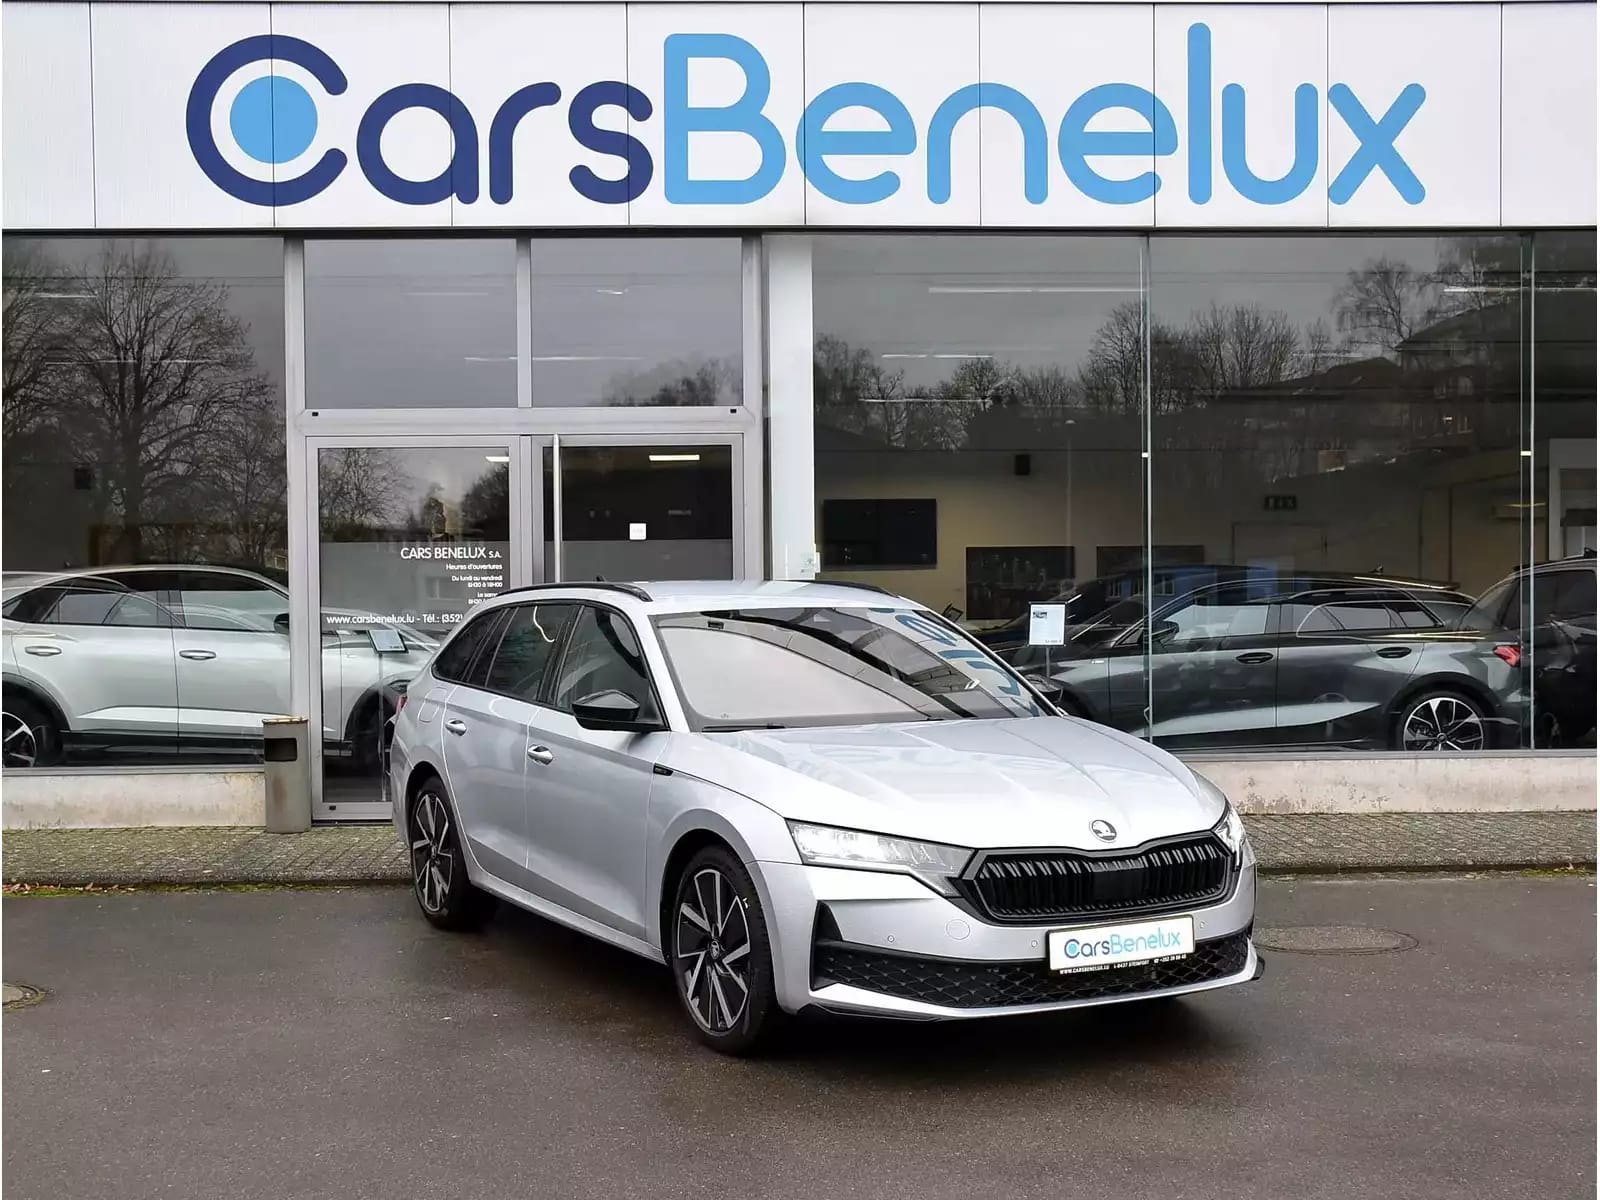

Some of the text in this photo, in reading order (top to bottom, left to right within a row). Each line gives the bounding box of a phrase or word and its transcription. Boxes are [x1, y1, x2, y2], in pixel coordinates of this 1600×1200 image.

[187, 23, 1426, 205] CarsBenelux
[400, 547, 503, 559] CARS BENELUX S.A.
[326, 614, 415, 624] www.carsbenelux.lu
[1064, 927, 1181, 959] CarsBenelux
